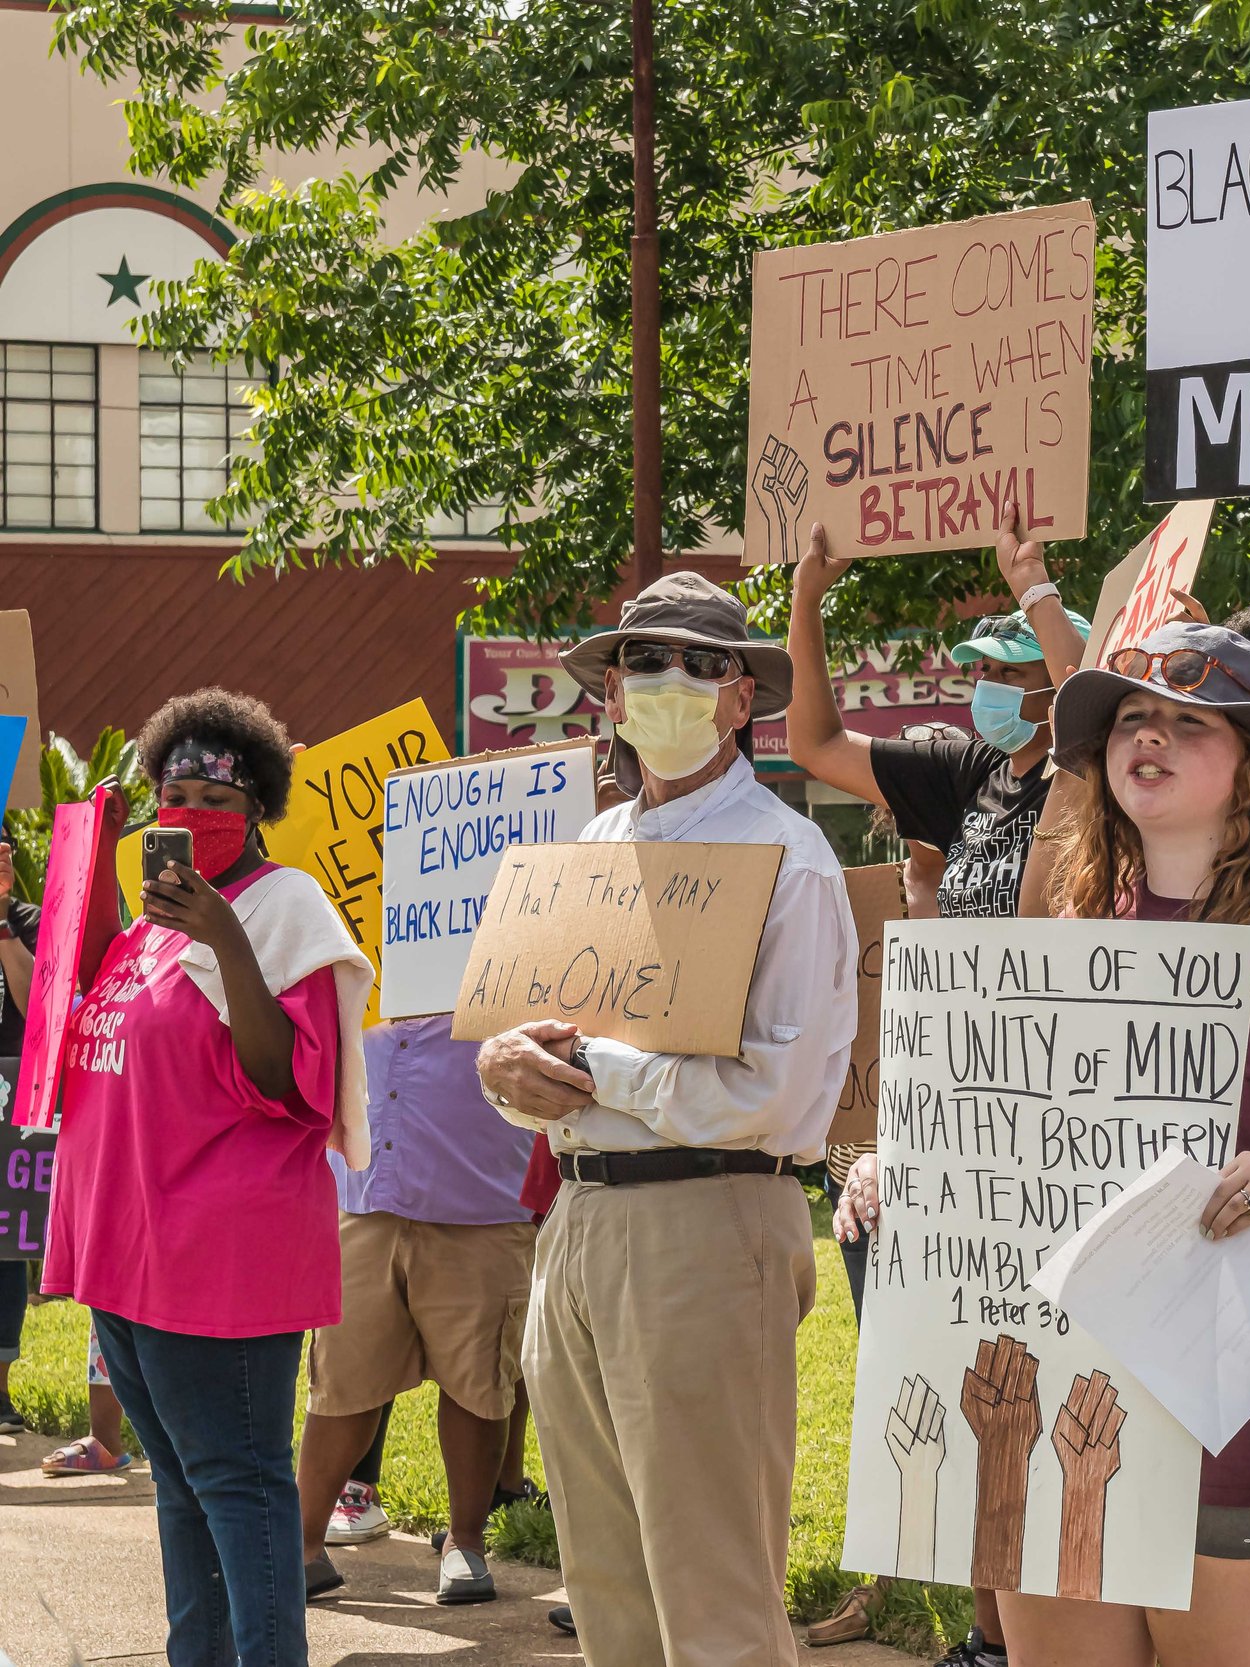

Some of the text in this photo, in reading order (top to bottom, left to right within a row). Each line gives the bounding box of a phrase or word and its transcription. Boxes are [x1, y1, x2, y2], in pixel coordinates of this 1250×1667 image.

[779, 225, 1090, 346] THERE COMES
[787, 314, 1086, 431] A TIME WHEN
[823, 390, 1063, 488] SILENCE IS
[855, 466, 1054, 546] BETRAYAL
[305, 730, 428, 830] YOUR
[385, 761, 567, 832] ENOUGH IS
[385, 900, 441, 945] BLACK
[500, 862, 564, 924] That
[587, 867, 645, 912] They
[469, 954, 519, 1008] All
[527, 966, 552, 1007] be
[886, 937, 988, 999] FINALLY,
[997, 946, 1064, 993] ALL
[1089, 945, 1137, 992] OF
[1158, 946, 1243, 1010] YOU,
[882, 1008, 934, 1059] HAVE
[947, 1009, 1058, 1092] UNITY
[1125, 1020, 1241, 1101] MIND
[878, 1077, 1024, 1167] SYMPATHY,
[1041, 1107, 1232, 1171] BROTHERLY
[939, 1171, 957, 1213] A
[888, 1230, 906, 1289] A
[950, 1286, 969, 1325] 1
[979, 1296, 1030, 1327] Peter
